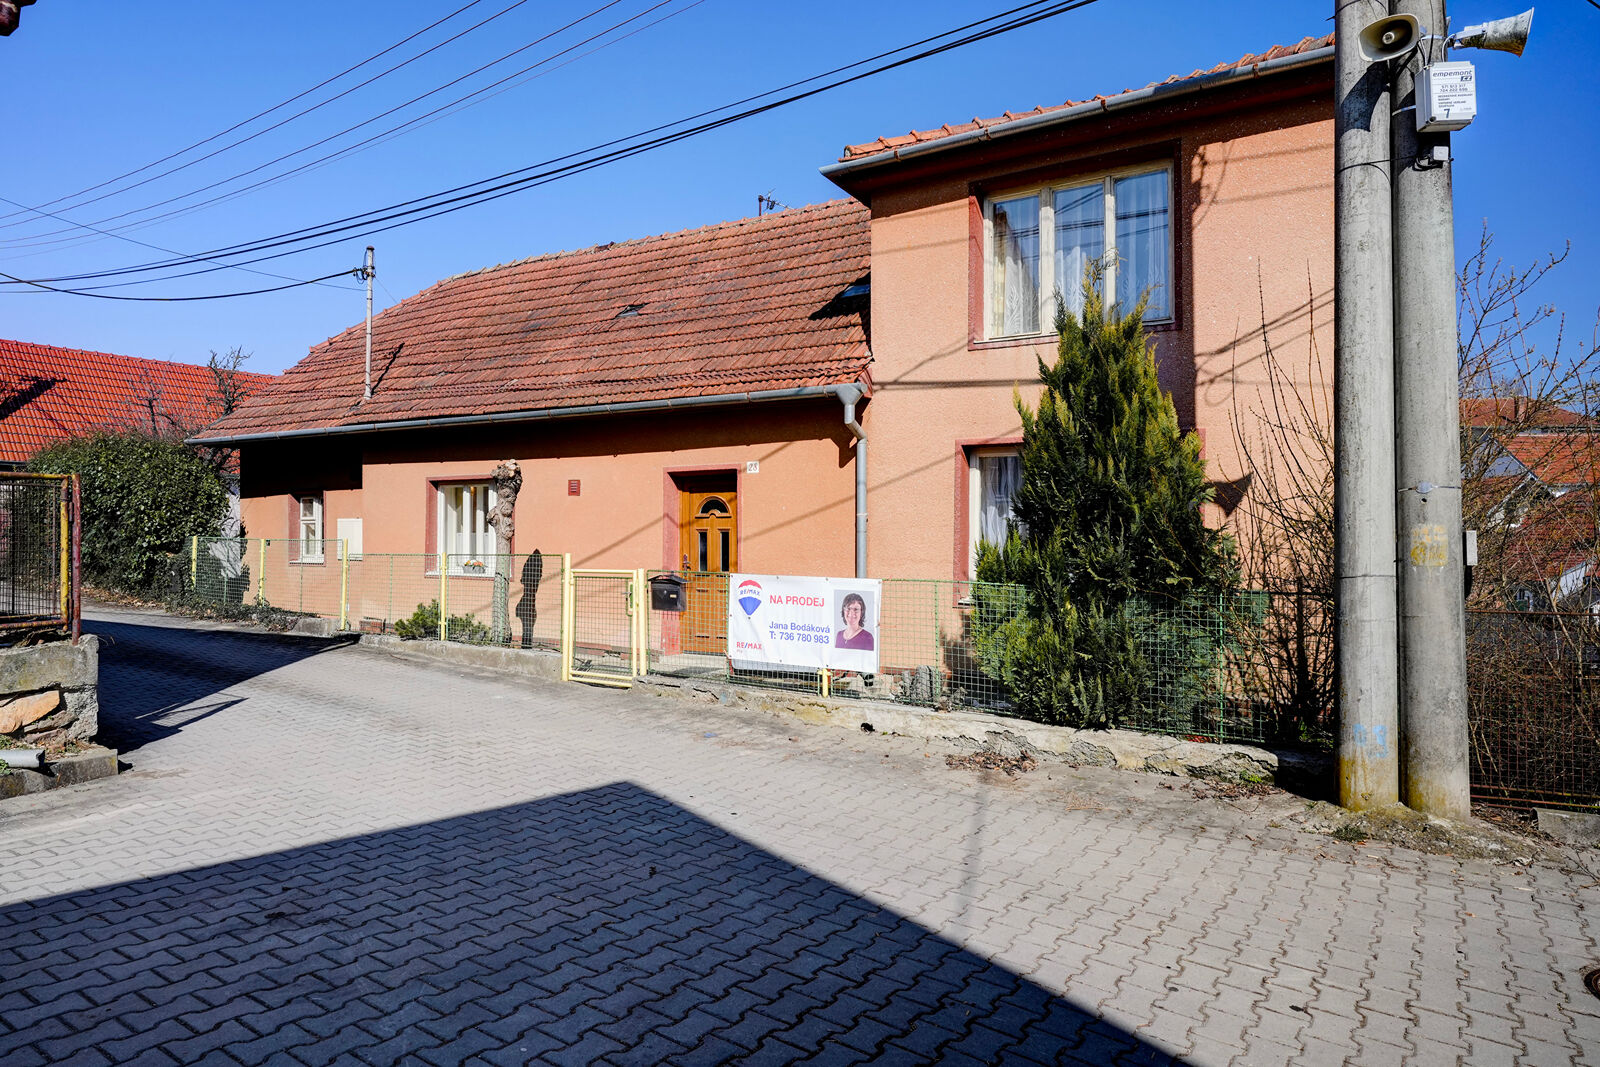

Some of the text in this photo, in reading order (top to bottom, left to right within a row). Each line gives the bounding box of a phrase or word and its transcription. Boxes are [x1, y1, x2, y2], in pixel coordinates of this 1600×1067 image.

[1443, 108, 1450, 118] 7
[769, 594, 825, 607] NA PRODEJ
[769, 621, 831, 633] Jana Bodáková
[769, 630, 830, 644] T: 736 780 983
[736, 641, 763, 650] RE/MAX
